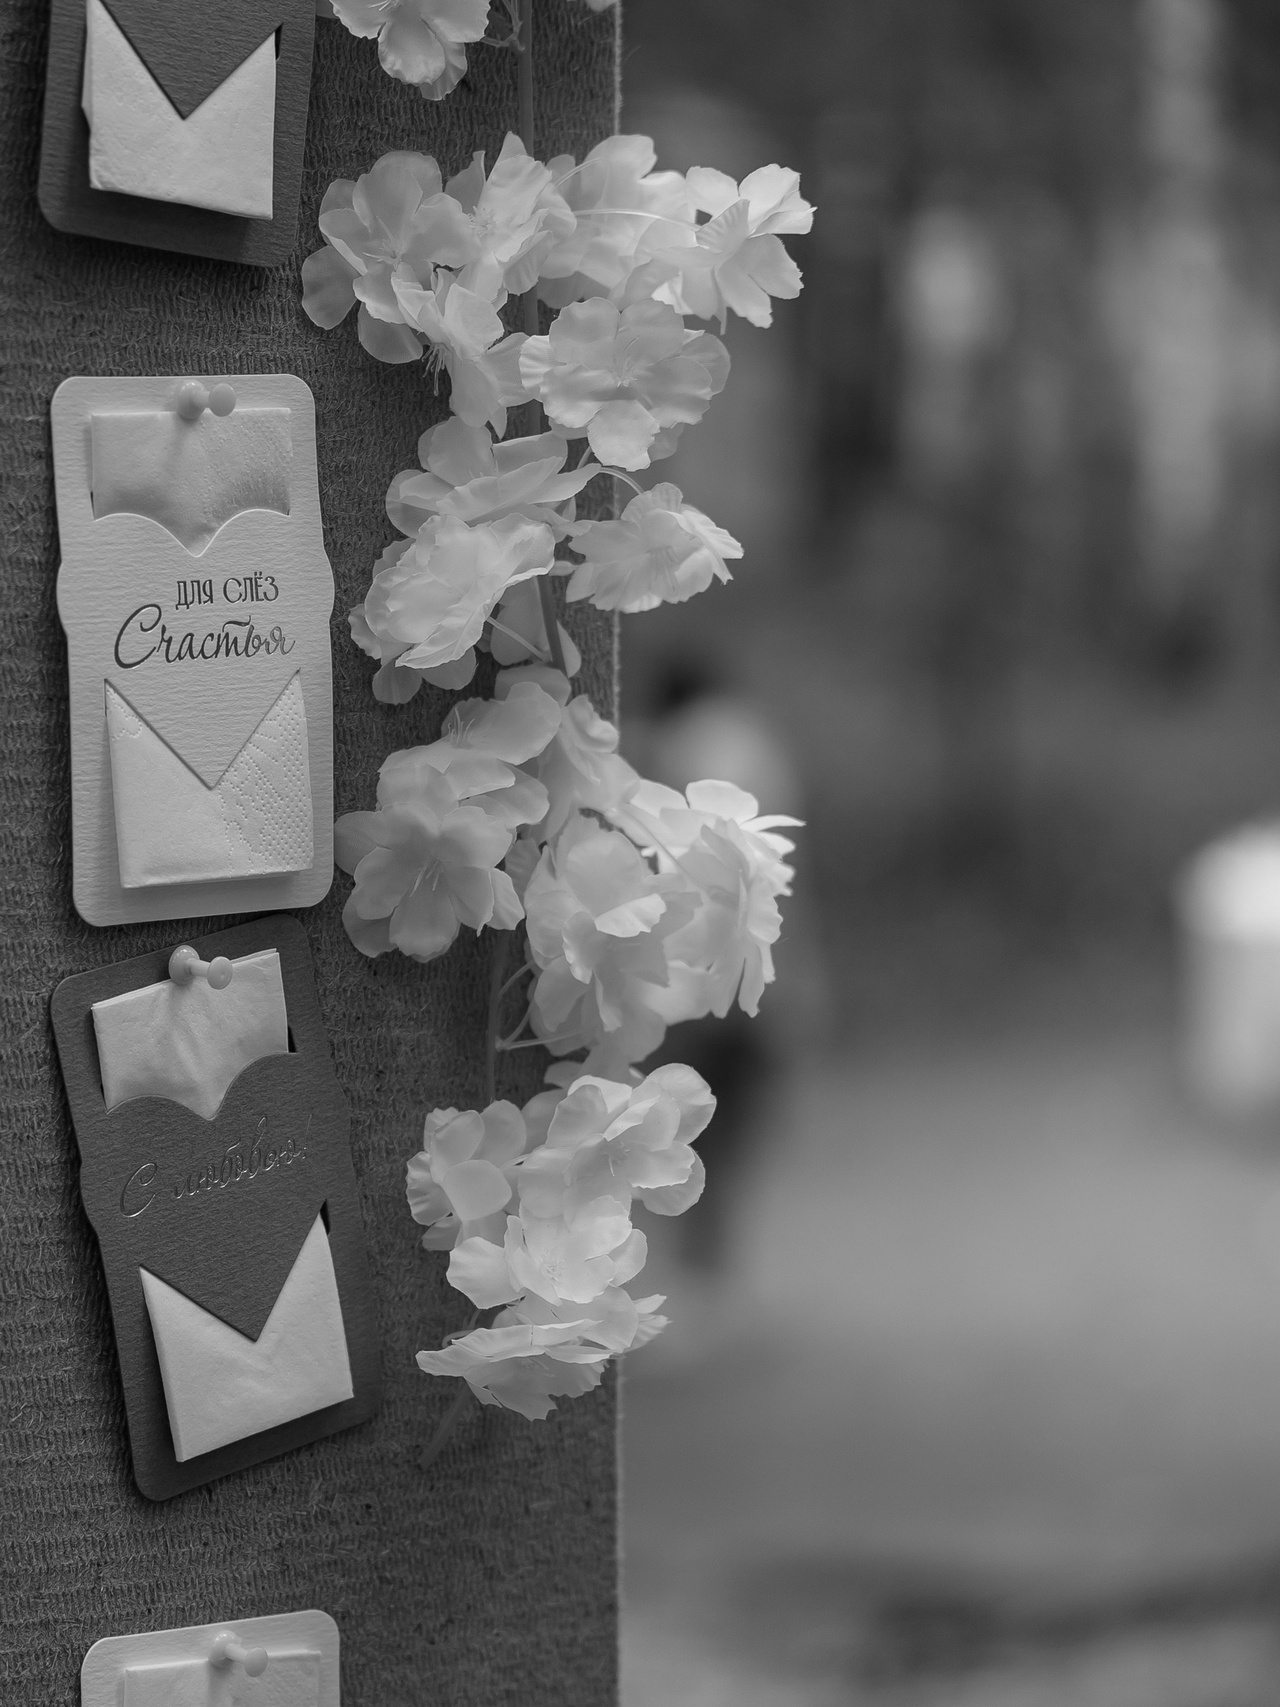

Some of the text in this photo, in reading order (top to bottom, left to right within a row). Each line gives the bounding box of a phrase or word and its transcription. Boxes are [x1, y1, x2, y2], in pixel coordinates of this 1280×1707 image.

[175, 570, 280, 611] ДЛЯ СЛЁЗ
[114, 603, 296, 670] Счастья
[119, 1162, 158, 1218] С
